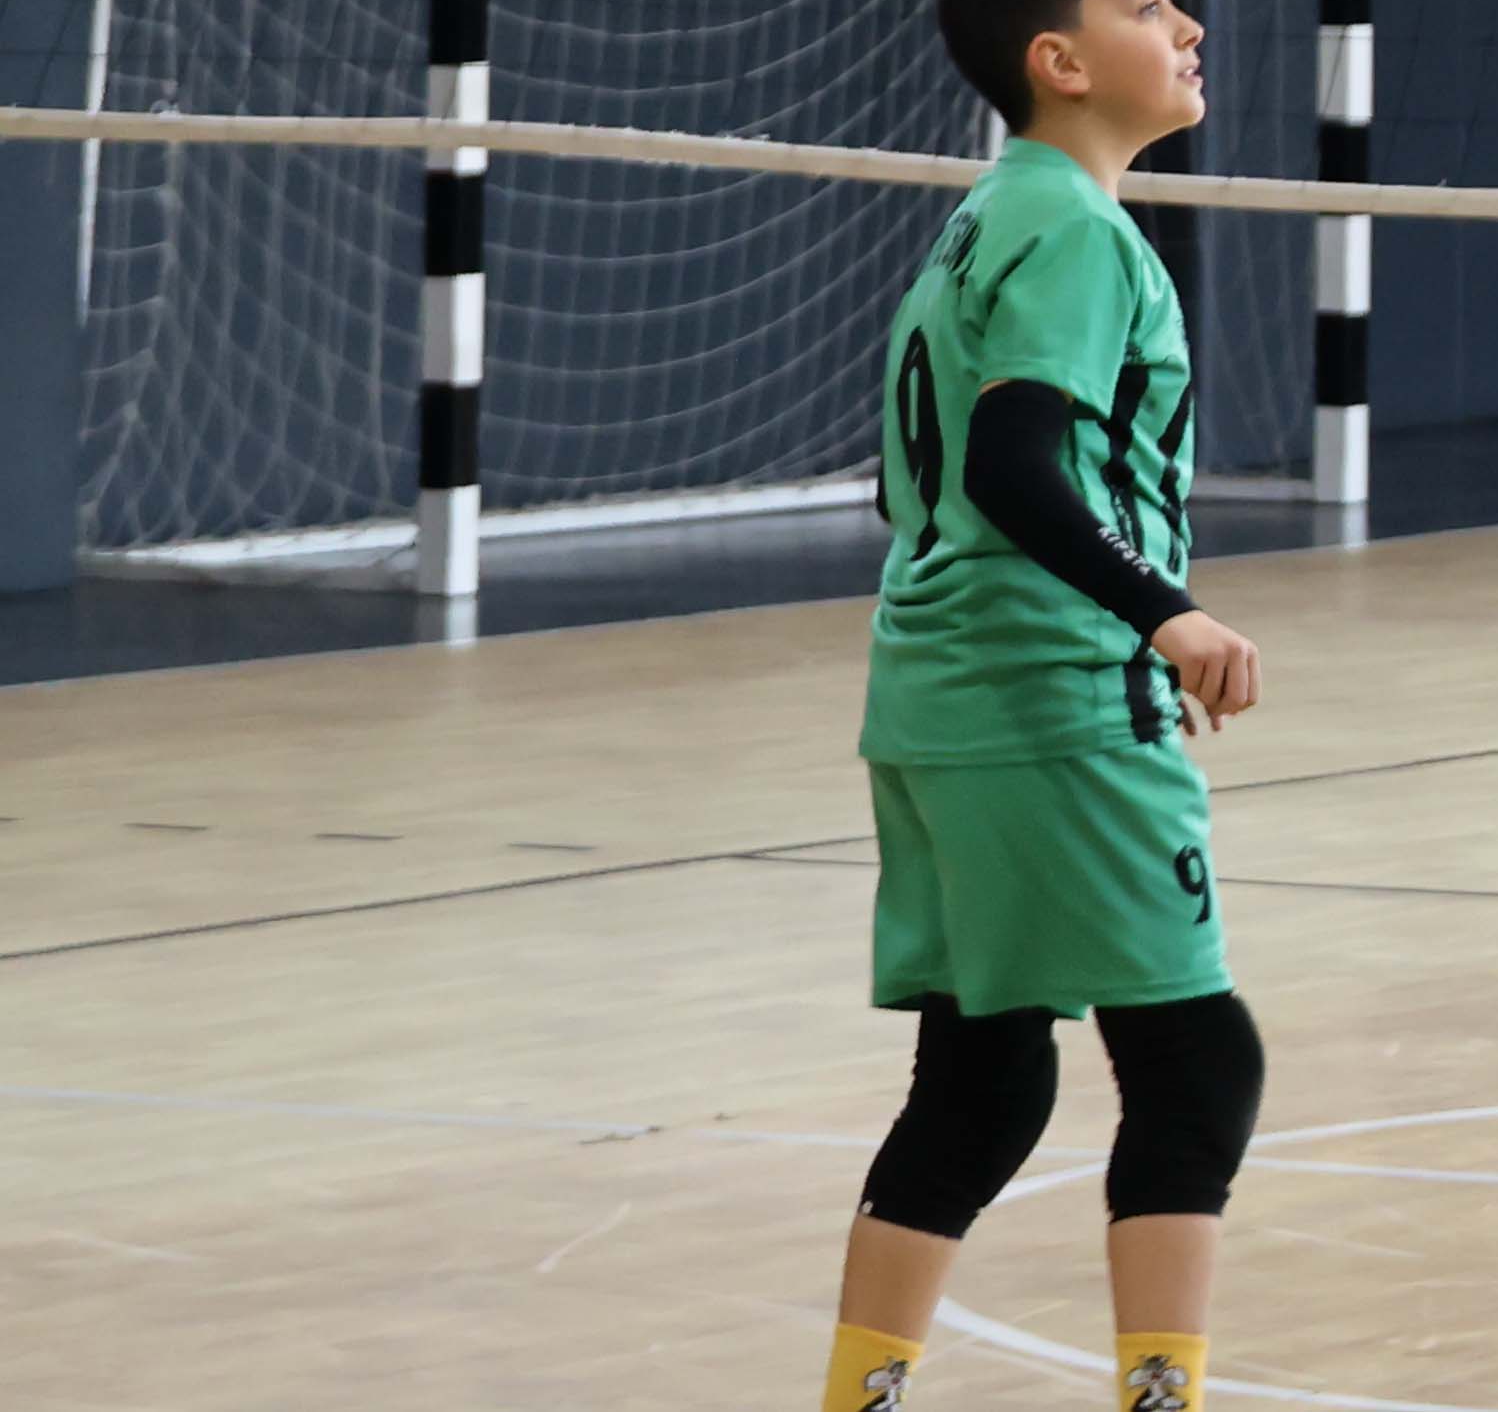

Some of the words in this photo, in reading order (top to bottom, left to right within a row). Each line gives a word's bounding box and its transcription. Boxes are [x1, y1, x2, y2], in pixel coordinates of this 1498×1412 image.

[895, 324, 945, 563] 9
[1097, 526, 1152, 576] KIPSTA
[1173, 844, 1211, 925] 9
